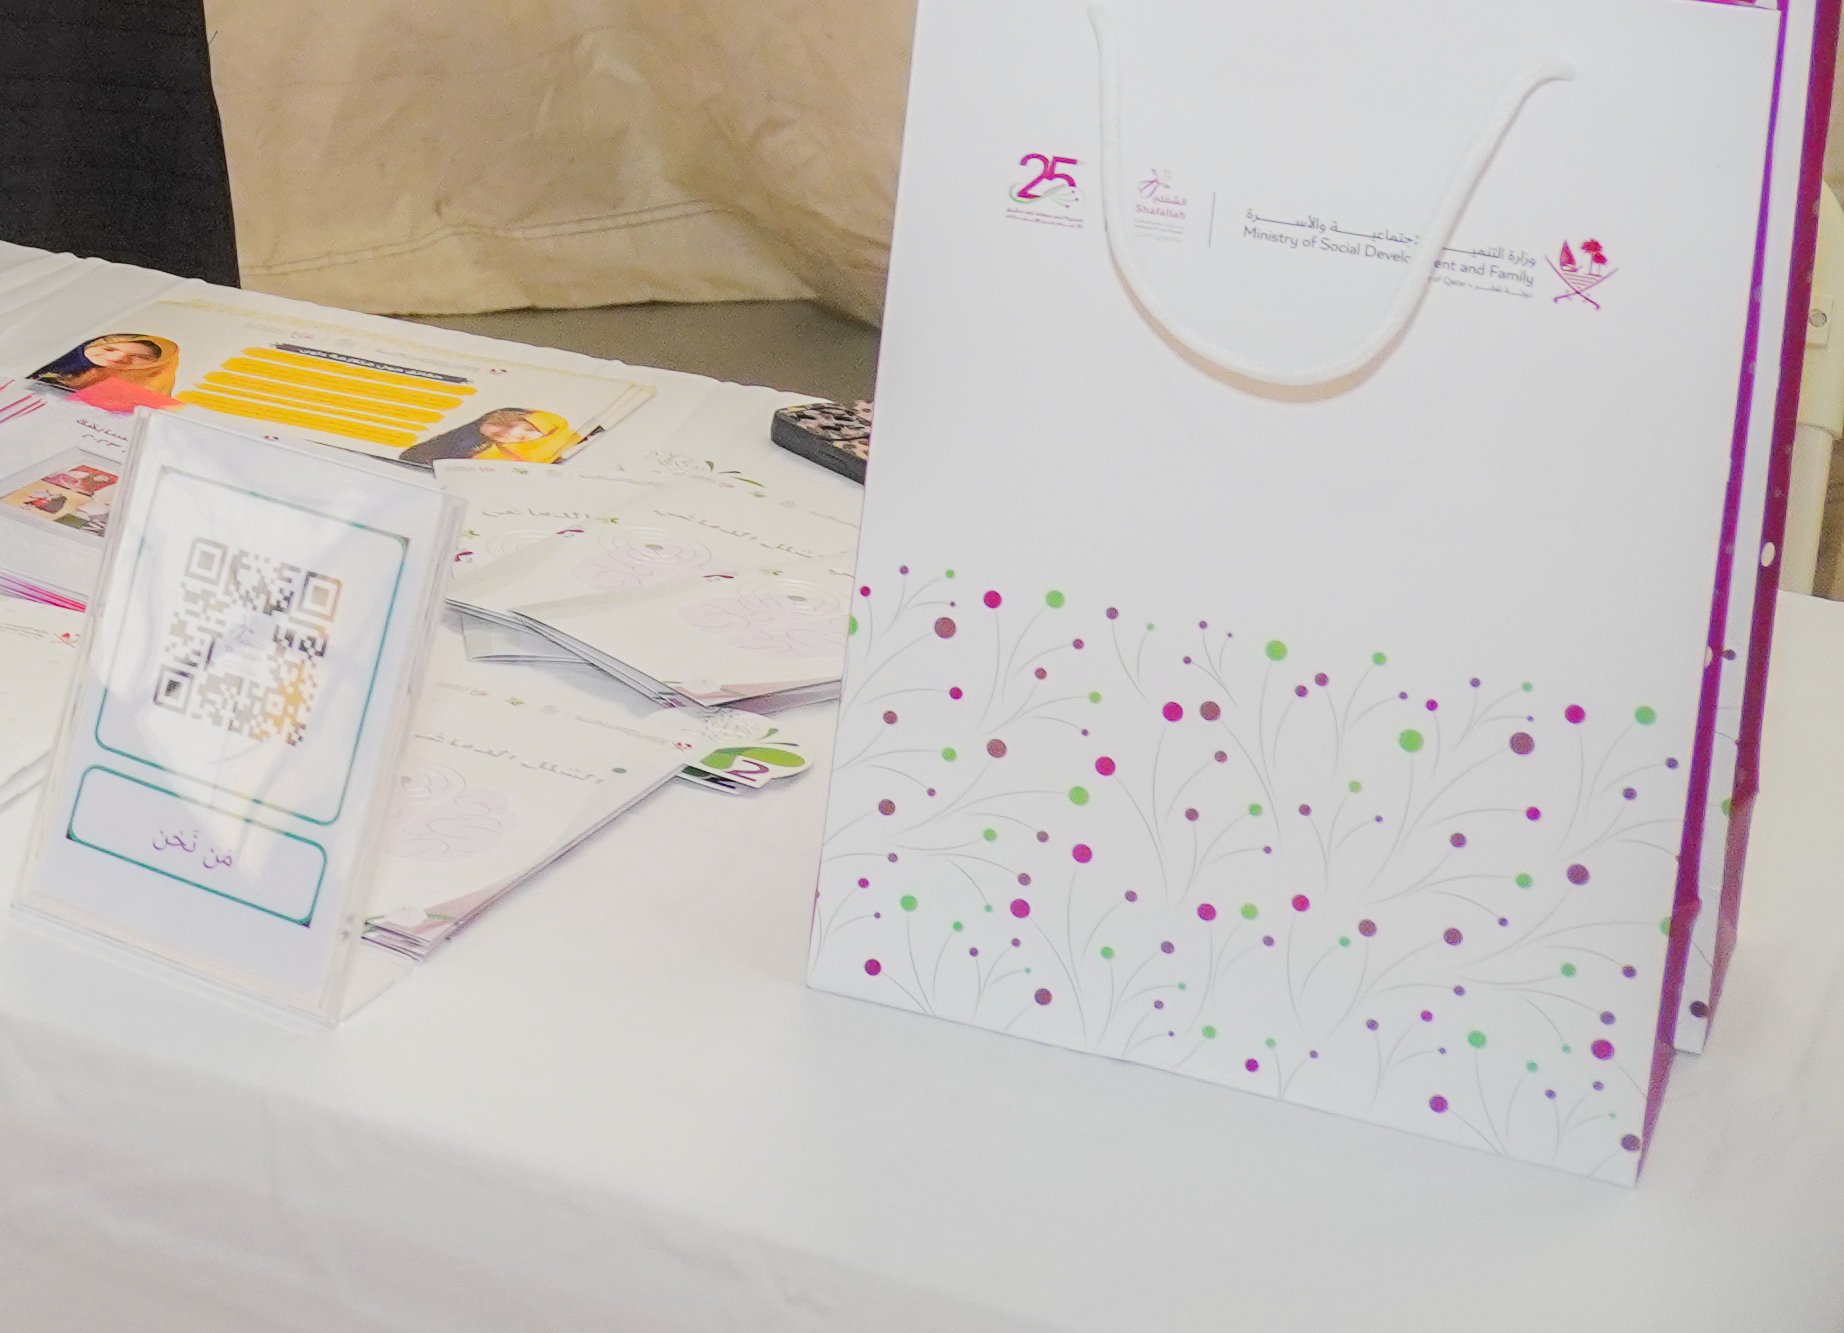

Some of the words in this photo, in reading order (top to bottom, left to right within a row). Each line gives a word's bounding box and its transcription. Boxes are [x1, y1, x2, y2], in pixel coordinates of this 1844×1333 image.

[1016, 152, 1078, 200] 25
[1135, 203, 1186, 220] Shafallah
[1243, 225, 1298, 249] Ministry
[1302, 236, 1317, 249] of
[1320, 237, 1361, 256] Social
[1460, 260, 1485, 276] and
[1490, 264, 1535, 287] Family
[1442, 245, 1506, 260] التنمي
[413, 731, 518, 760] الدماغ
